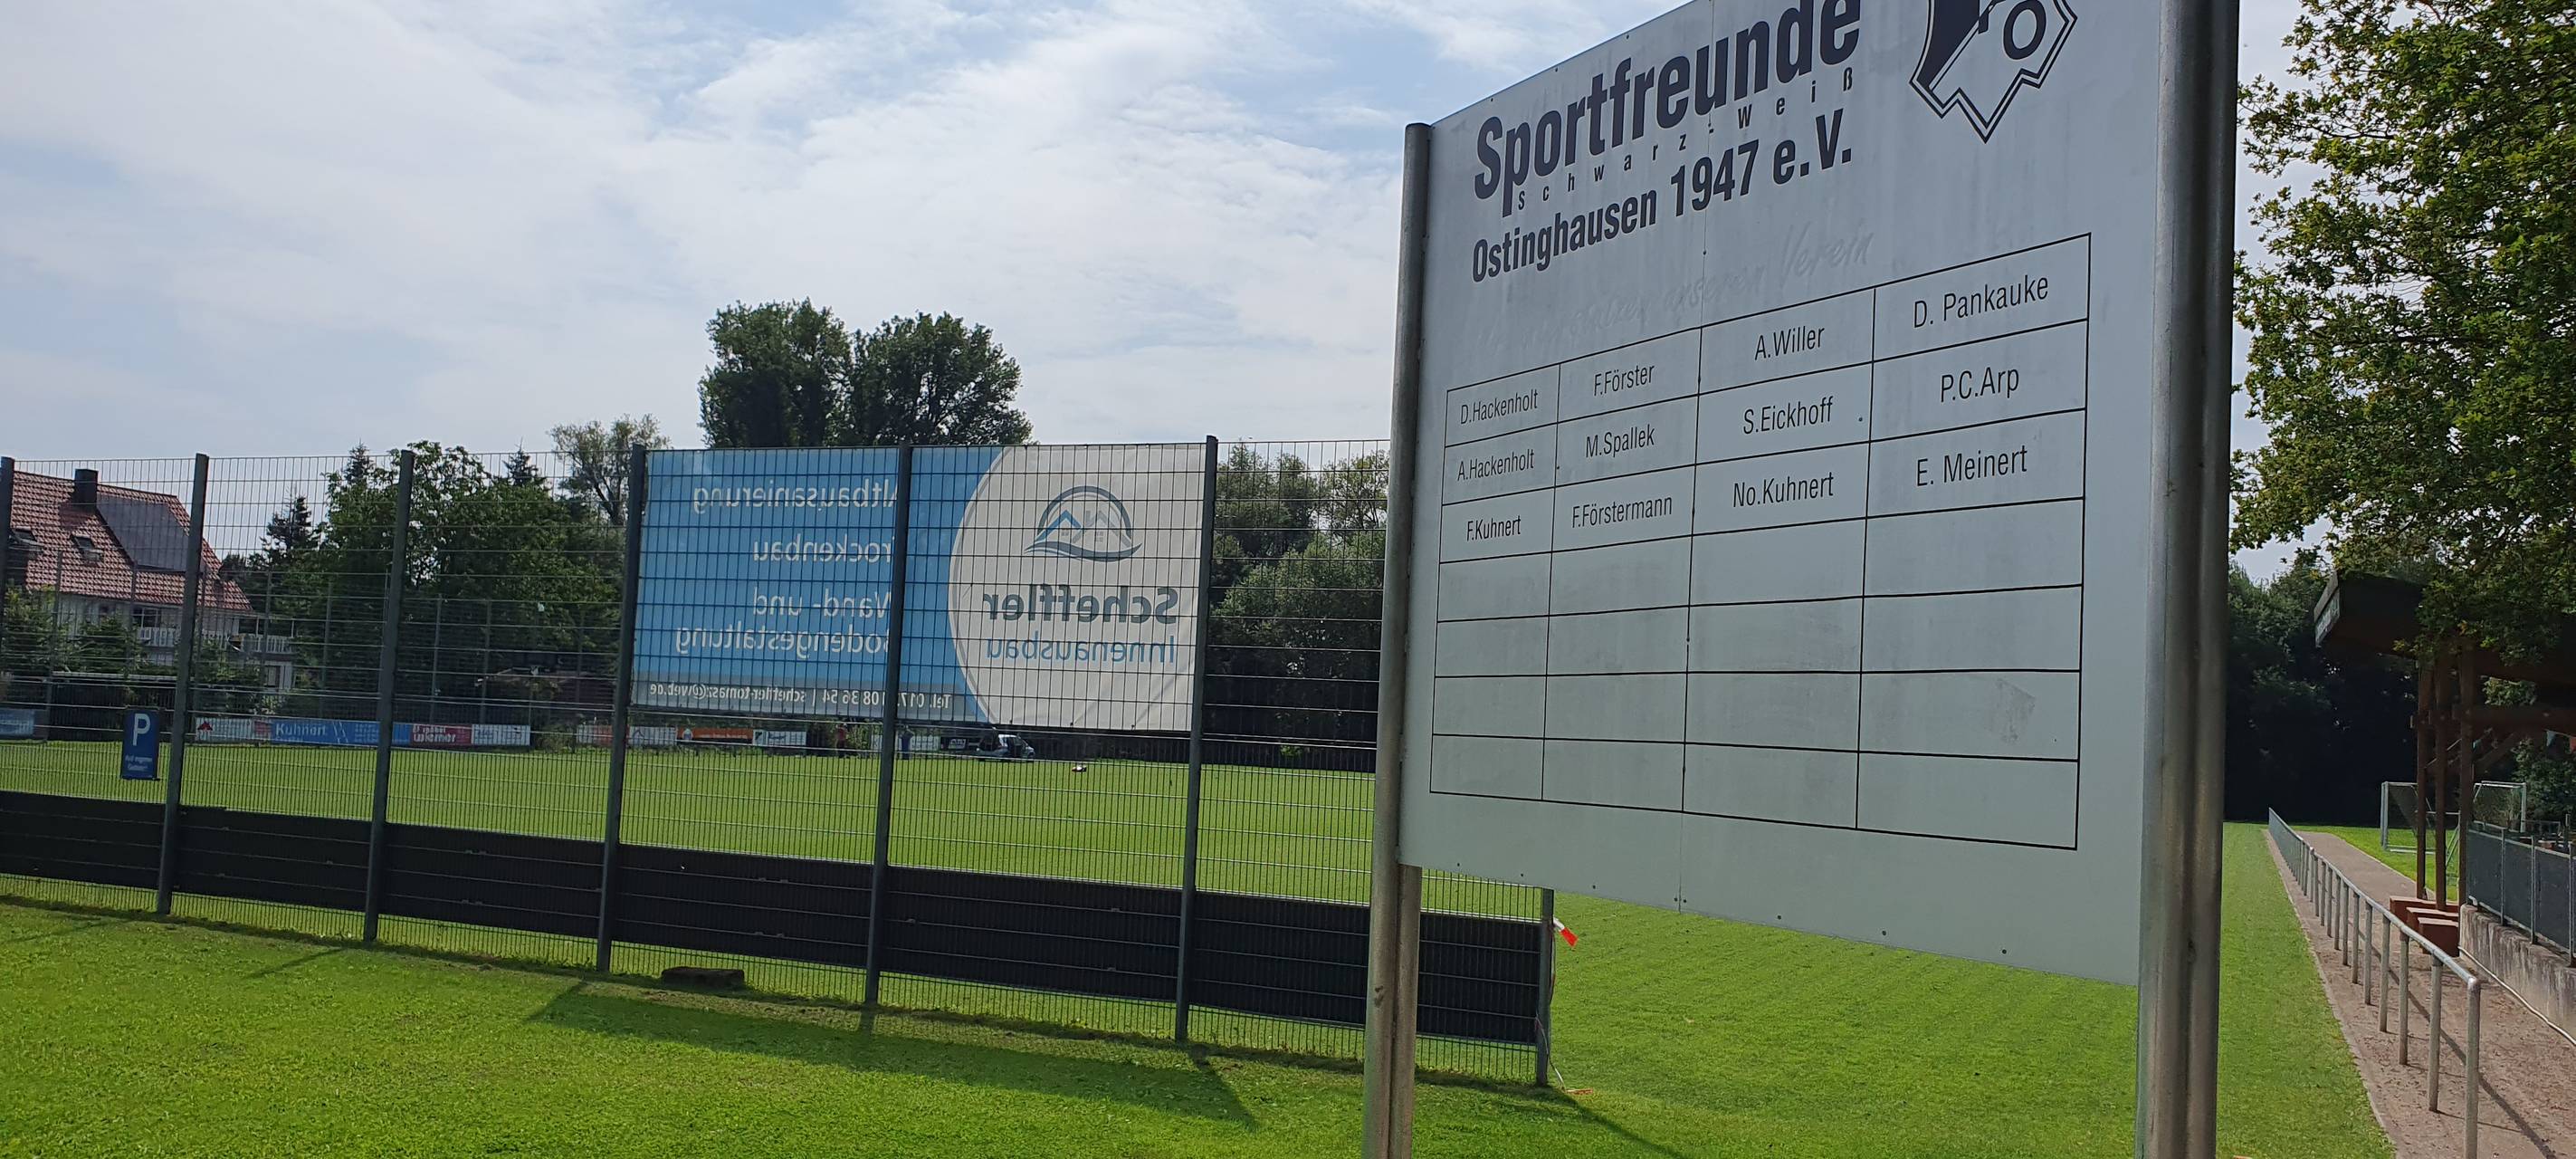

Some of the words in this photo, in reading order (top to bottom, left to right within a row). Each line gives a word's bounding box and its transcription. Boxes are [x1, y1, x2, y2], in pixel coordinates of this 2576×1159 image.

[1474, 0, 1860, 217] Sportfreunde
[1473, 189, 1656, 283] Ostinghausen
[1671, 139, 1759, 216] 1947
[1773, 108, 1852, 186] e.V.
[1913, 300, 1934, 329] D.
[1943, 274, 2049, 321] Pankauke
[1754, 326, 1825, 361] A.Willer
[1594, 365, 1655, 397] F.Förster
[1941, 366, 2020, 403] P.C.Arp
[1460, 388, 1538, 425] D.Hackenholt
[1743, 396, 1834, 435] S.Eickhoff
[1586, 424, 1655, 458] M.Spallek
[1457, 449, 1534, 481] A.Hackenholt
[1917, 458, 1934, 487] E.
[1943, 445, 2027, 484] Meinert
[1733, 472, 1834, 508] No.Kuhnert
[1466, 515, 1522, 541] F.Kuhnert
[1572, 496, 1673, 529] F.Förstermann
[133, 713, 151, 746] P
